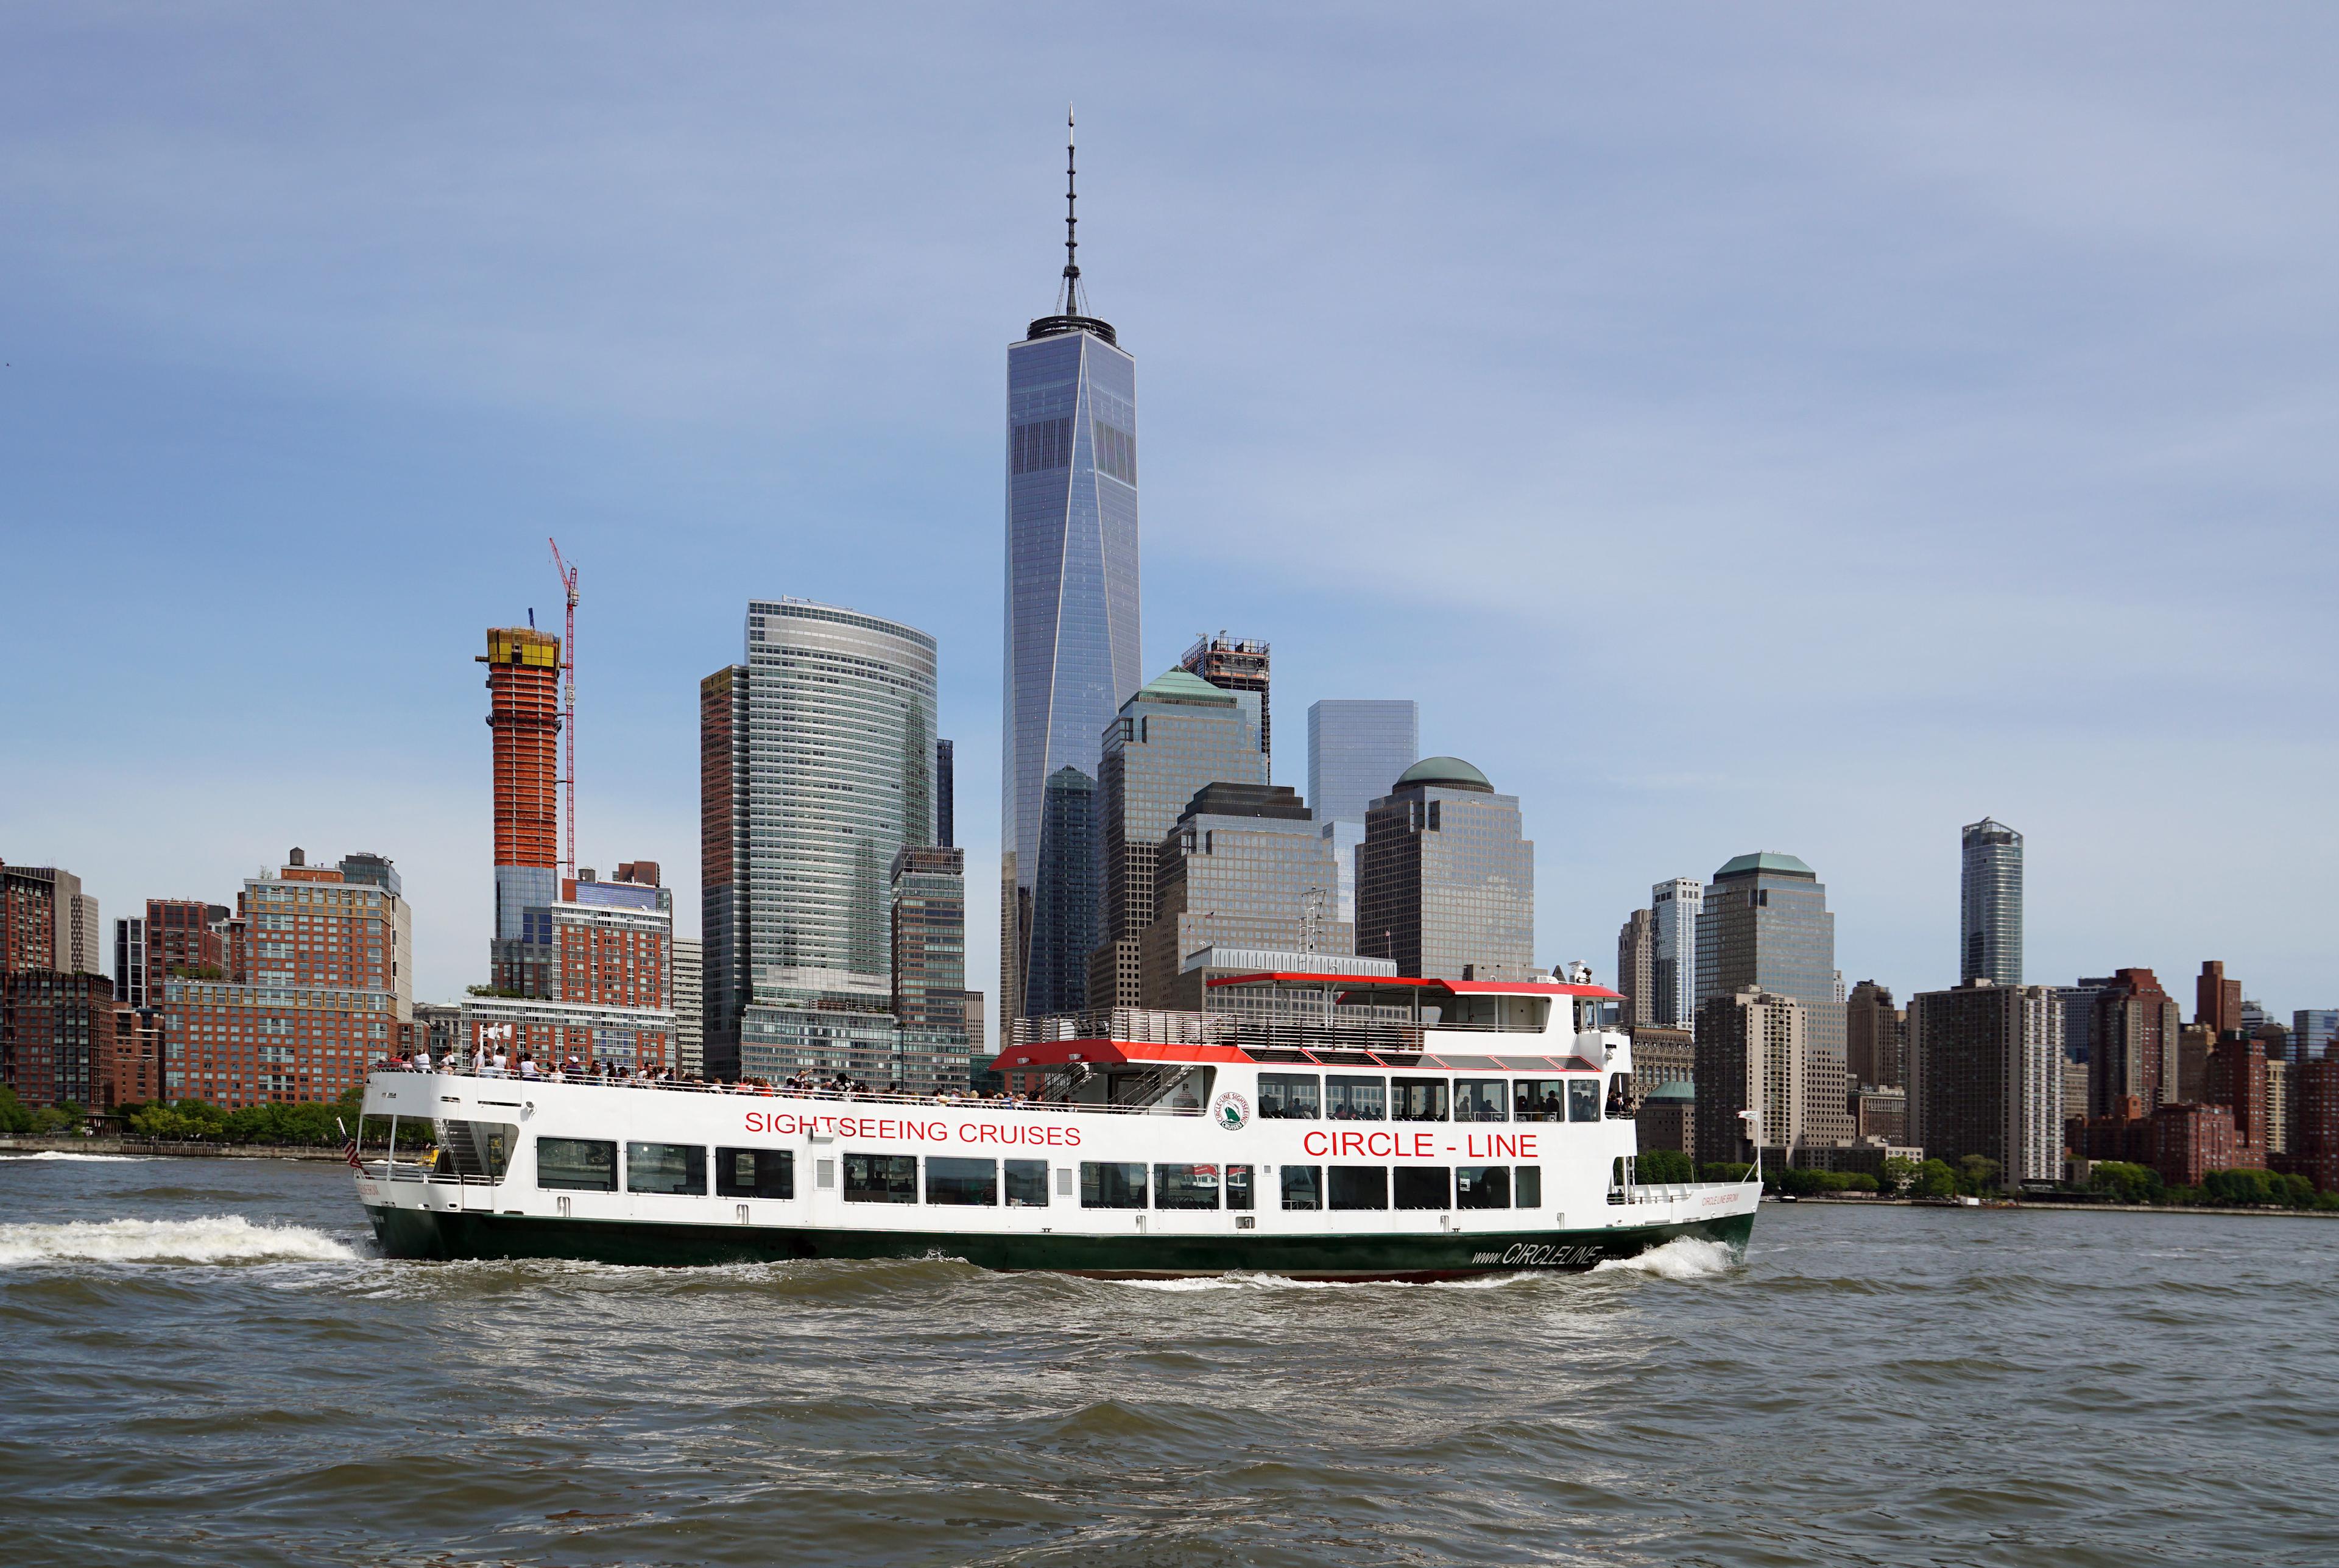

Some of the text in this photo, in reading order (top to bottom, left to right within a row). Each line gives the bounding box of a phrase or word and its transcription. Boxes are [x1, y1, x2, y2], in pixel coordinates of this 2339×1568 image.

[1232, 1093, 1249, 1124] SIGHTSEEING
[745, 1112, 1081, 1146] SIGHTSEEING CRUISES
[1221, 1121, 1243, 1130] CRUISES
[1304, 1131, 1434, 1157] CIRCLE
[1467, 1134, 1539, 1158] LINE
[1702, 1196, 1717, 1206] CIRCLE
